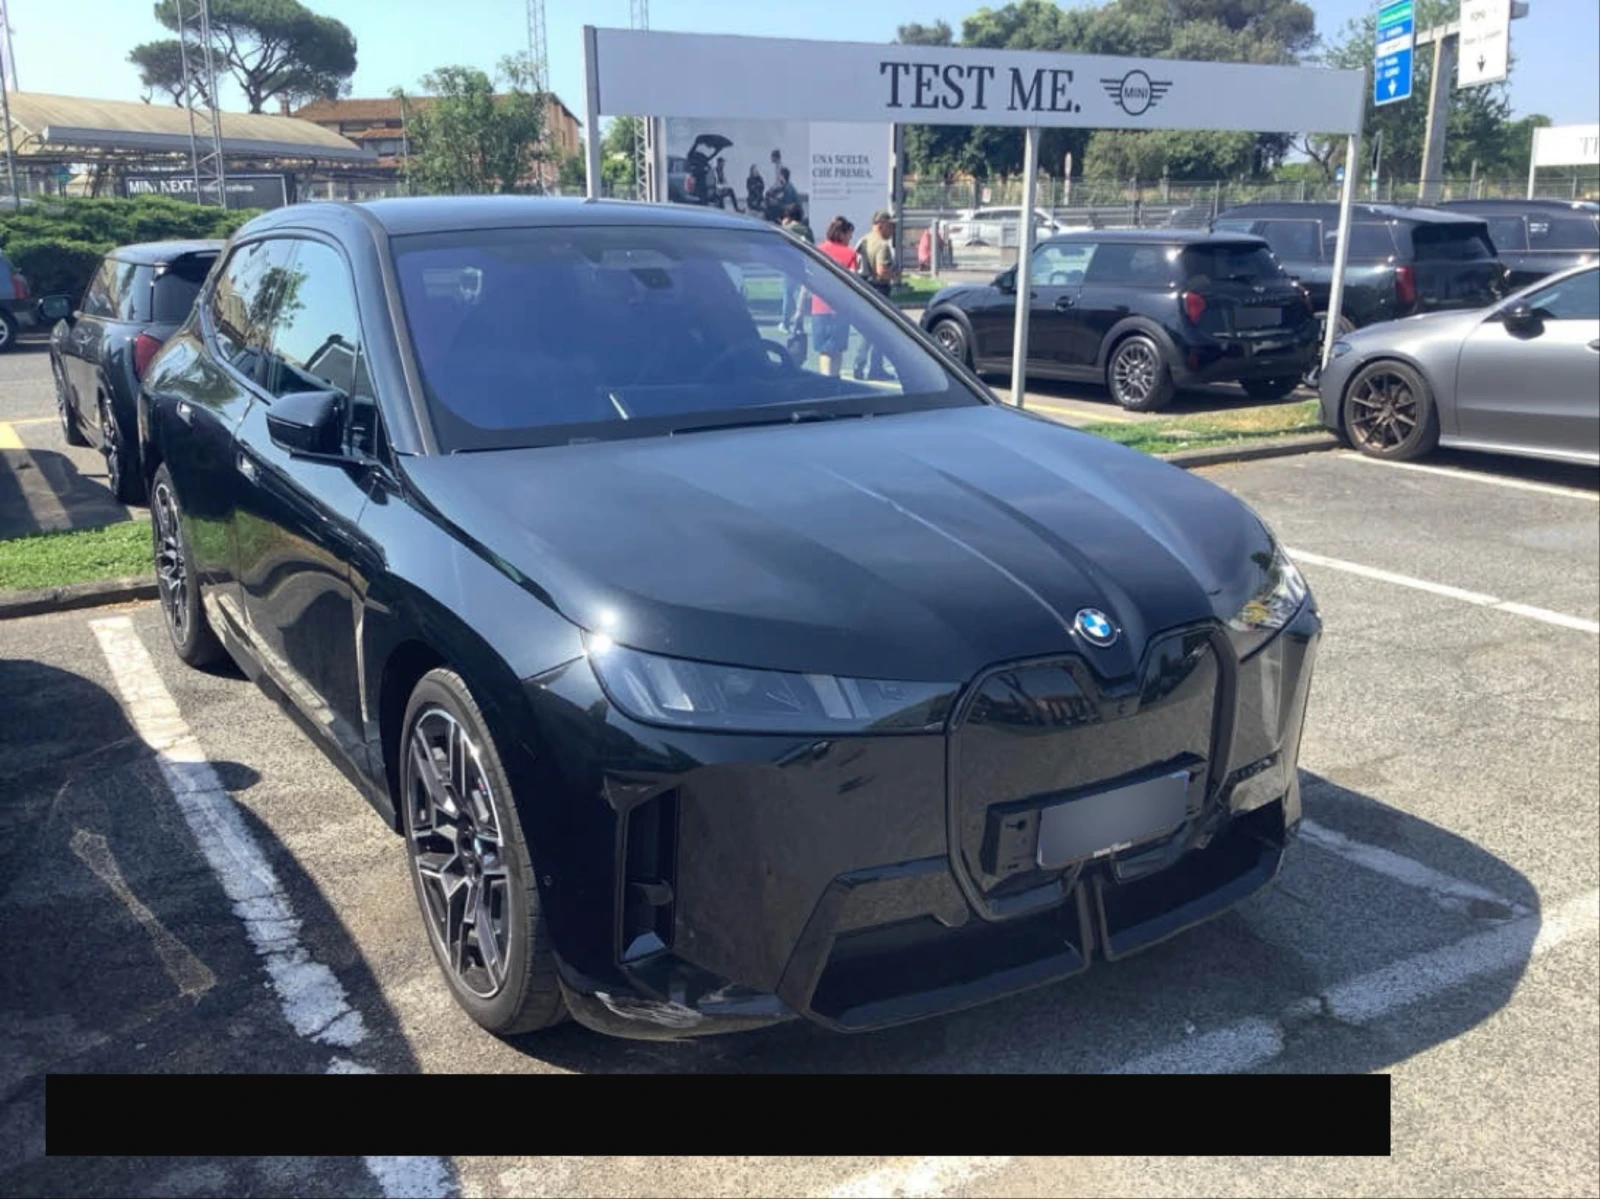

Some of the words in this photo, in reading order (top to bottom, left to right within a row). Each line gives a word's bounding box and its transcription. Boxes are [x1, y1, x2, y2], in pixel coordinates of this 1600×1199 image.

[880, 61, 995, 110] TEST
[1006, 67, 1081, 113] ME.
[1124, 87, 1149, 99] MINI
[812, 153, 833, 165] UNA
[835, 153, 870, 165] SCELTA
[812, 167, 833, 178] CHE
